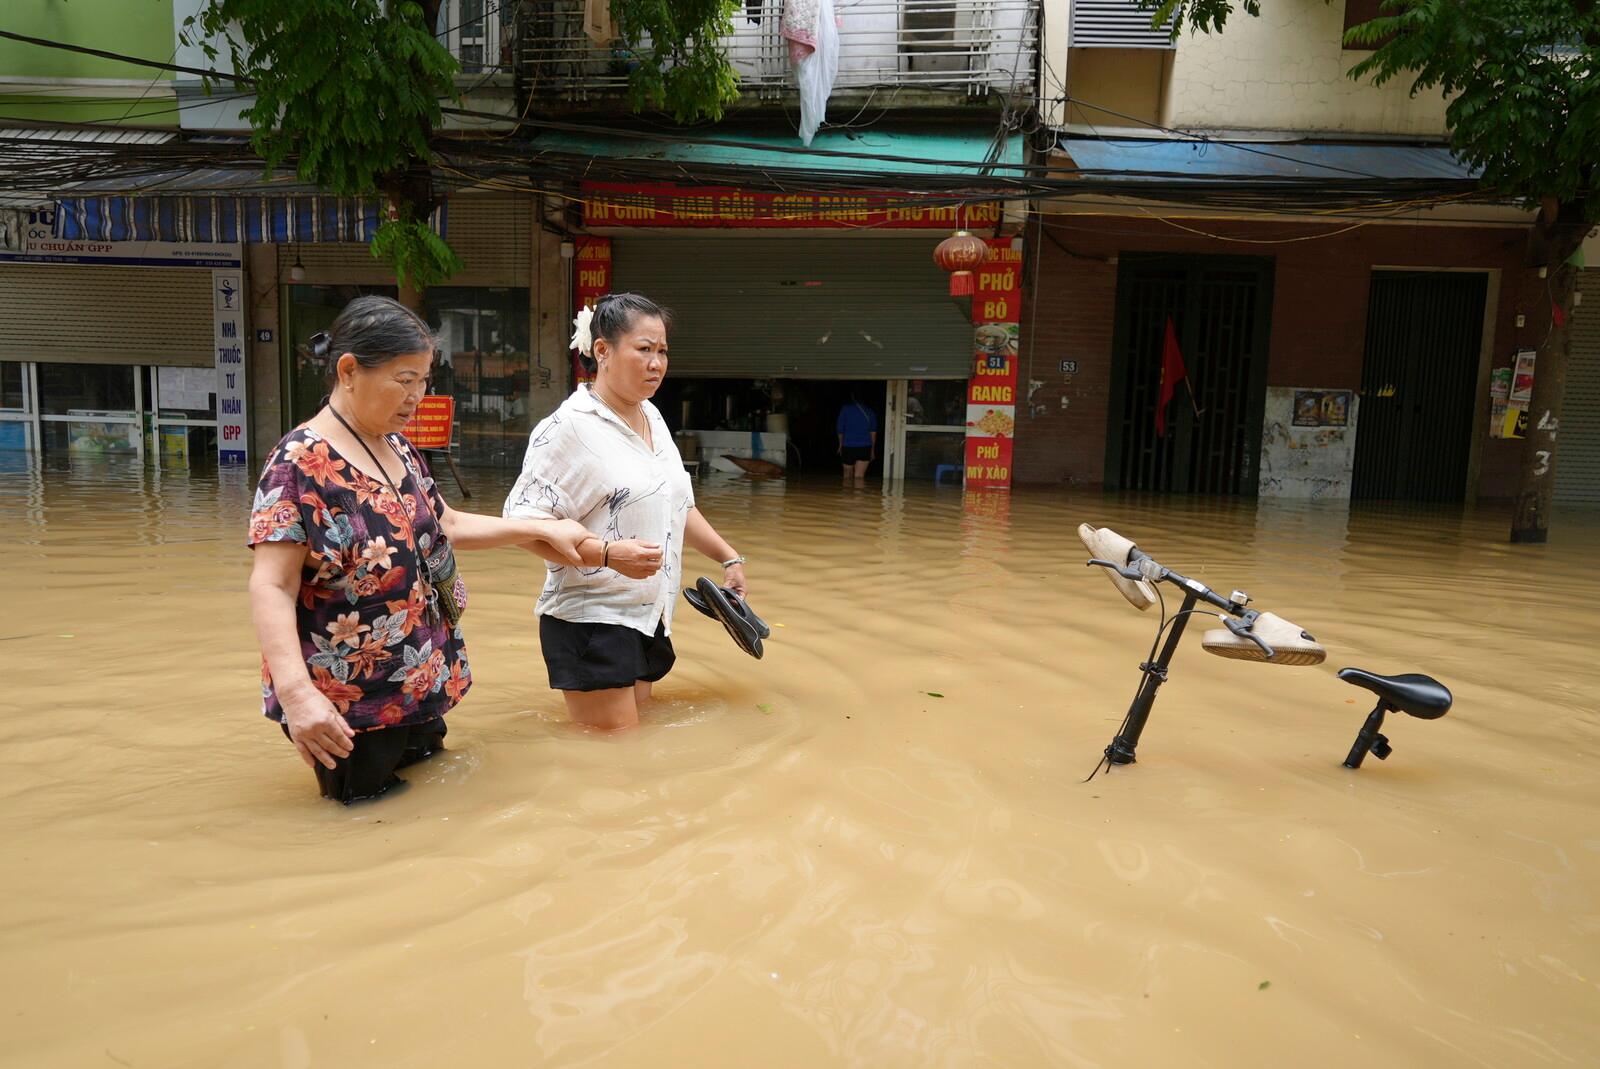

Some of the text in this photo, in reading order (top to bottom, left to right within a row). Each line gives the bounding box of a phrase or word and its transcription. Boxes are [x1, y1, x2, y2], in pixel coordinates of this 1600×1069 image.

[818, 196, 869, 221] RANG
[87, 244, 113, 253] GPP
[579, 265, 606, 288] PHỞ
[979, 267, 1015, 291] PHỞ
[984, 297, 1007, 319] BÒ
[221, 319, 237, 338] NHÀ
[260, 331, 270, 341] 49
[219, 343, 241, 364] THUỐC
[989, 357, 1001, 368] 51
[1062, 361, 1076, 372] 53
[225, 373, 236, 389] TƯ
[972, 386, 1012, 402] RANG
[221, 396, 242, 415] NHÂN
[223, 425, 241, 441] GPP
[976, 442, 1000, 459] PHỞ
[986, 464, 1008, 481] XÀO
